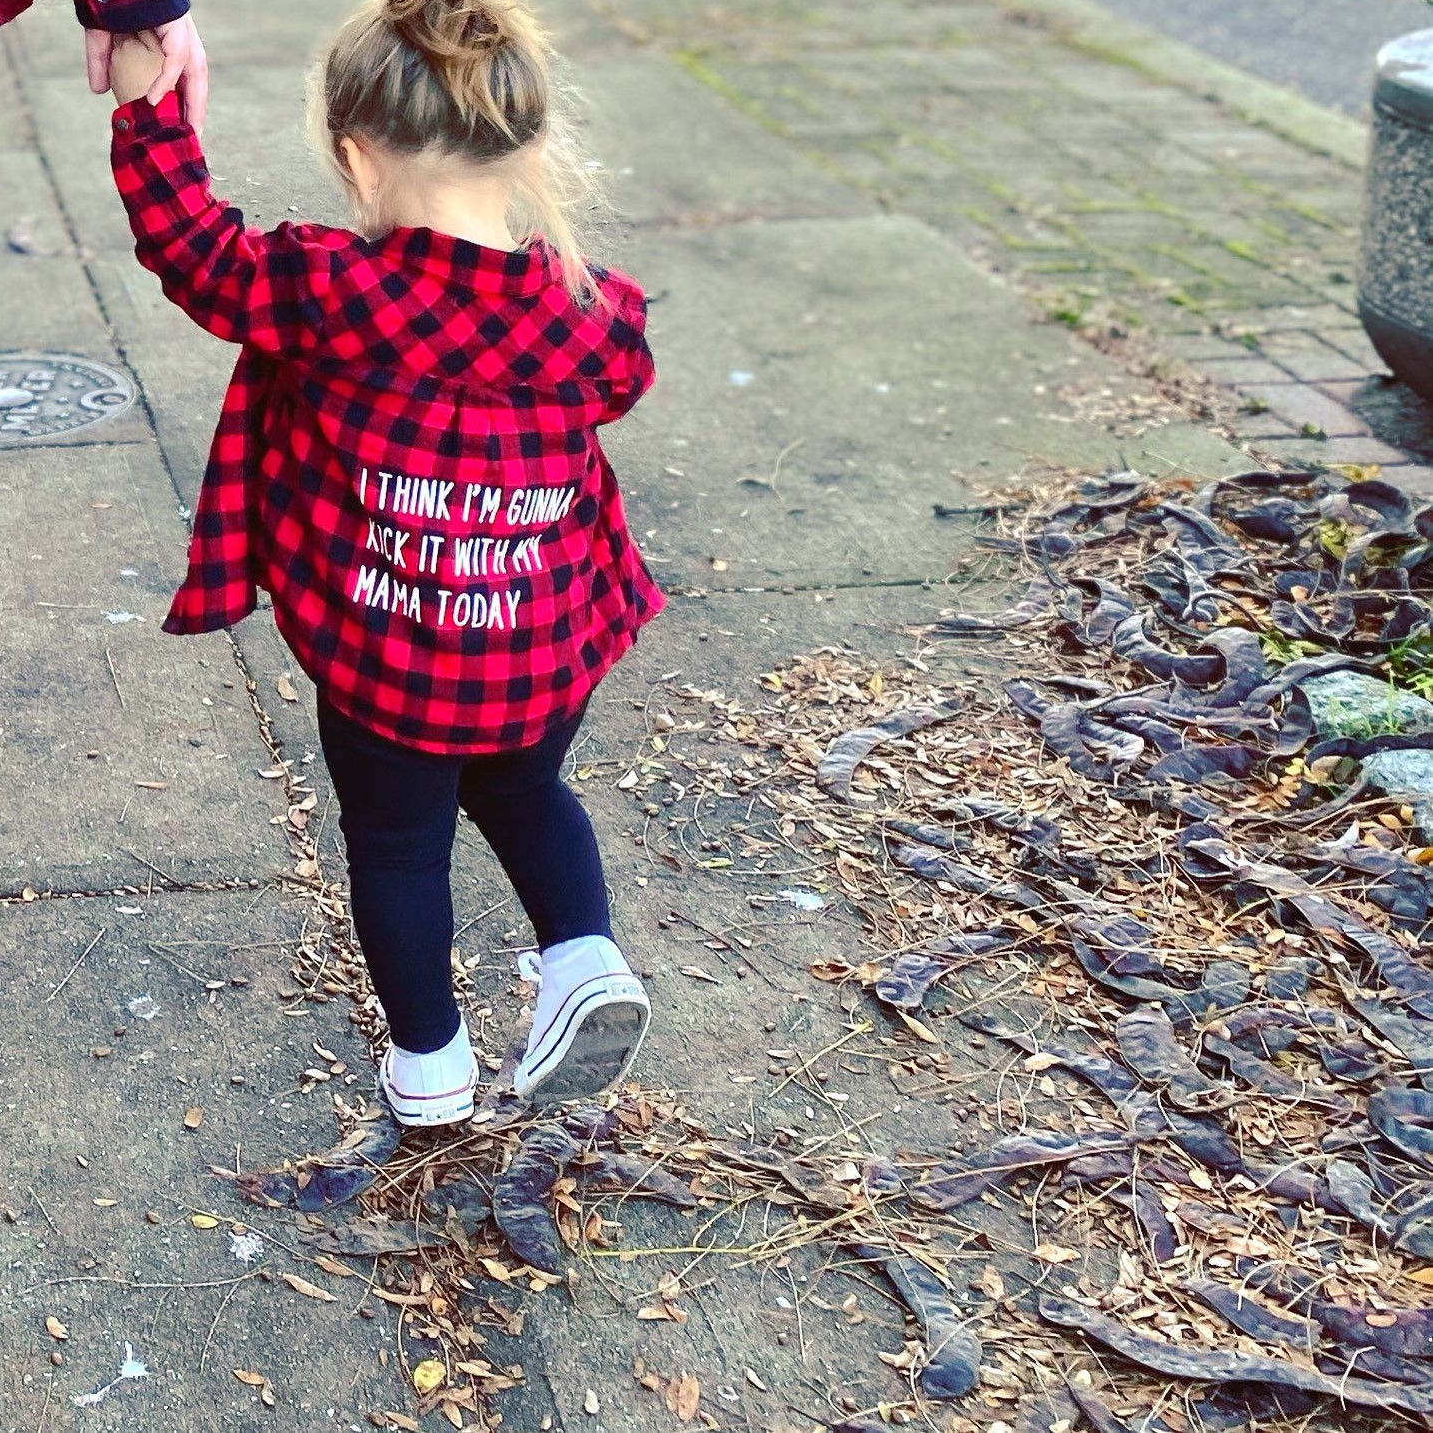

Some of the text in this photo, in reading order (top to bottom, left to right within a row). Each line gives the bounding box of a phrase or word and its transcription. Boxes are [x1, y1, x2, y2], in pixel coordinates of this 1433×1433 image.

[0, 370, 57, 430] MEER
[360, 467, 576, 527] I THINK I'M GUNNA
[365, 517, 543, 578] KICK IT WITH MY
[352, 565, 522, 631] MAMA TODAY
